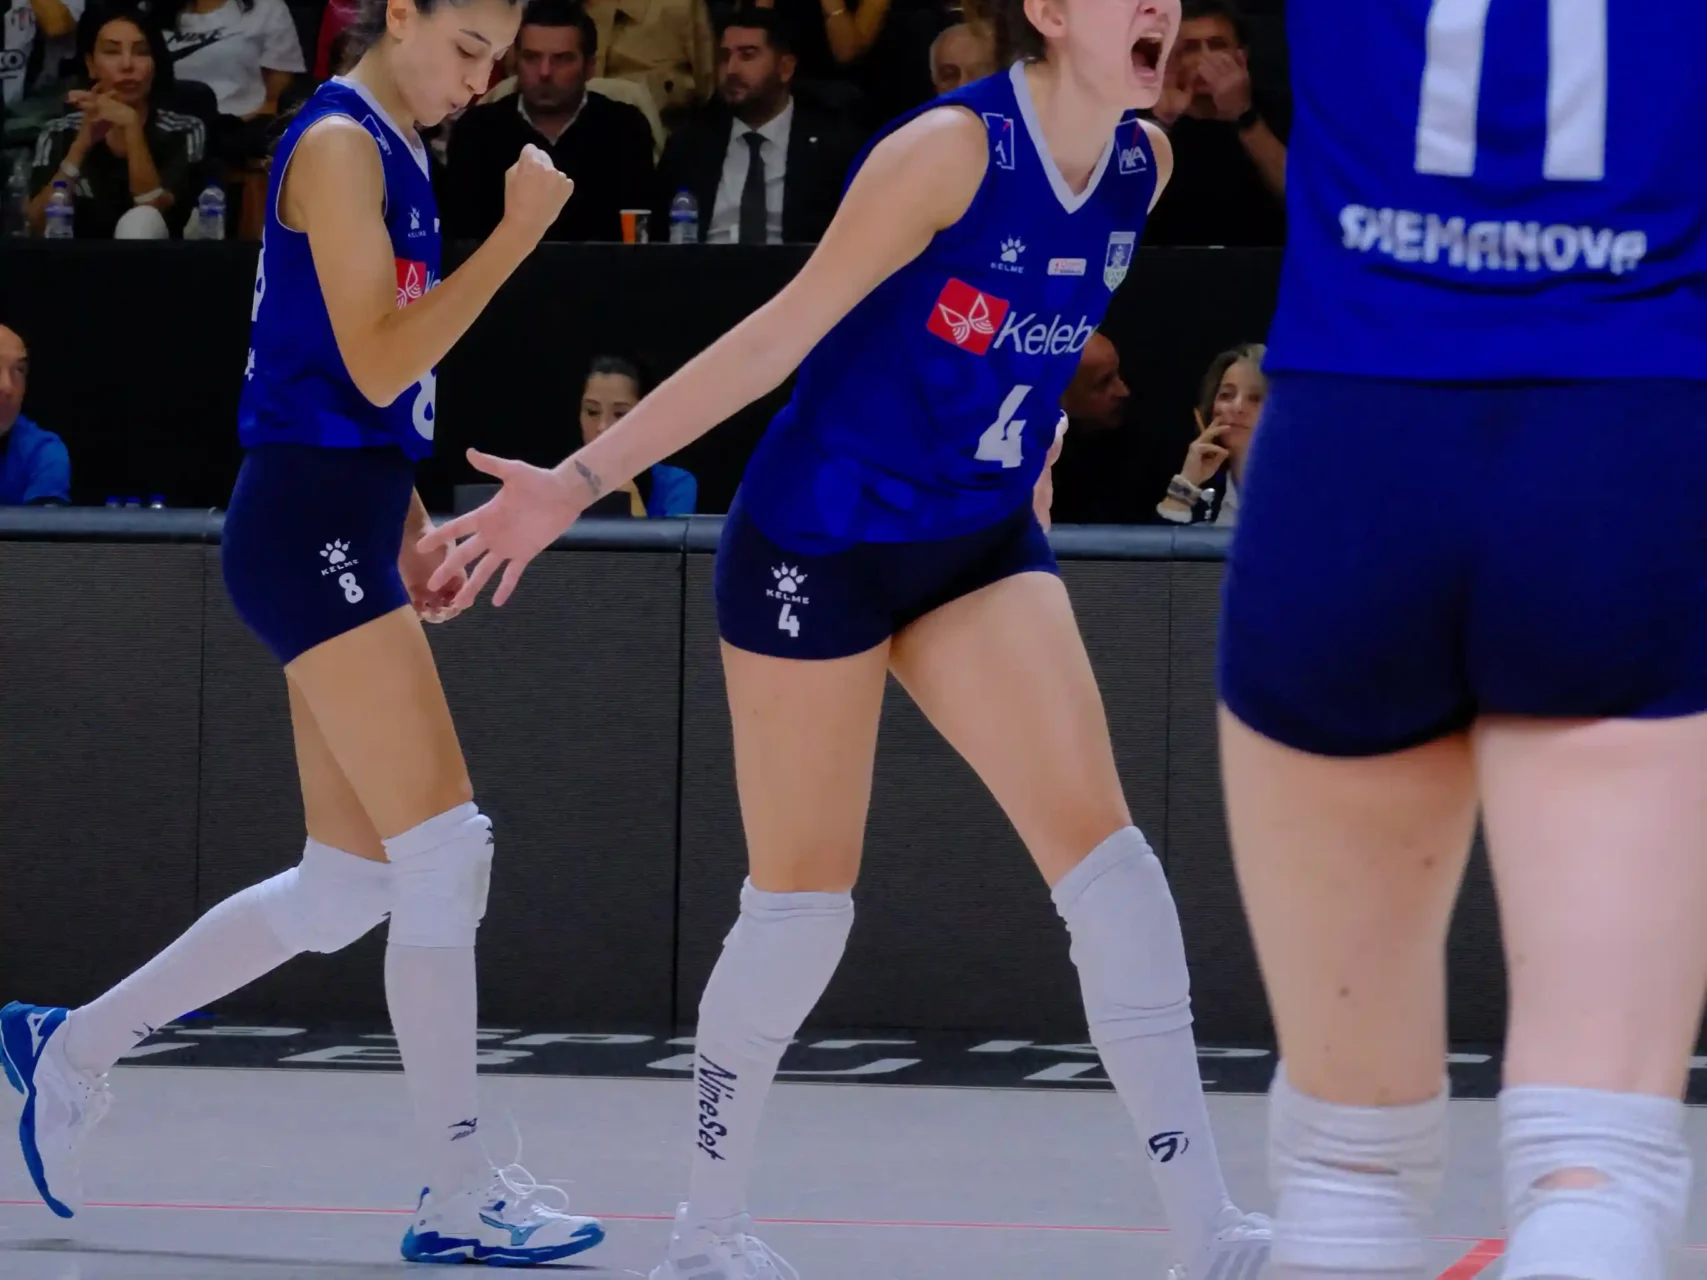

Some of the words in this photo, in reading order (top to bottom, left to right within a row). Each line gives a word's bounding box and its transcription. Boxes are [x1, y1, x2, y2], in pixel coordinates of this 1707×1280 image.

[993, 311, 1100, 356] Keleb
[974, 384, 1034, 469] 4
[320, 559, 360, 577] KELME
[338, 571, 365, 604] 8
[765, 588, 810, 605] KELME
[778, 603, 800, 638] 4
